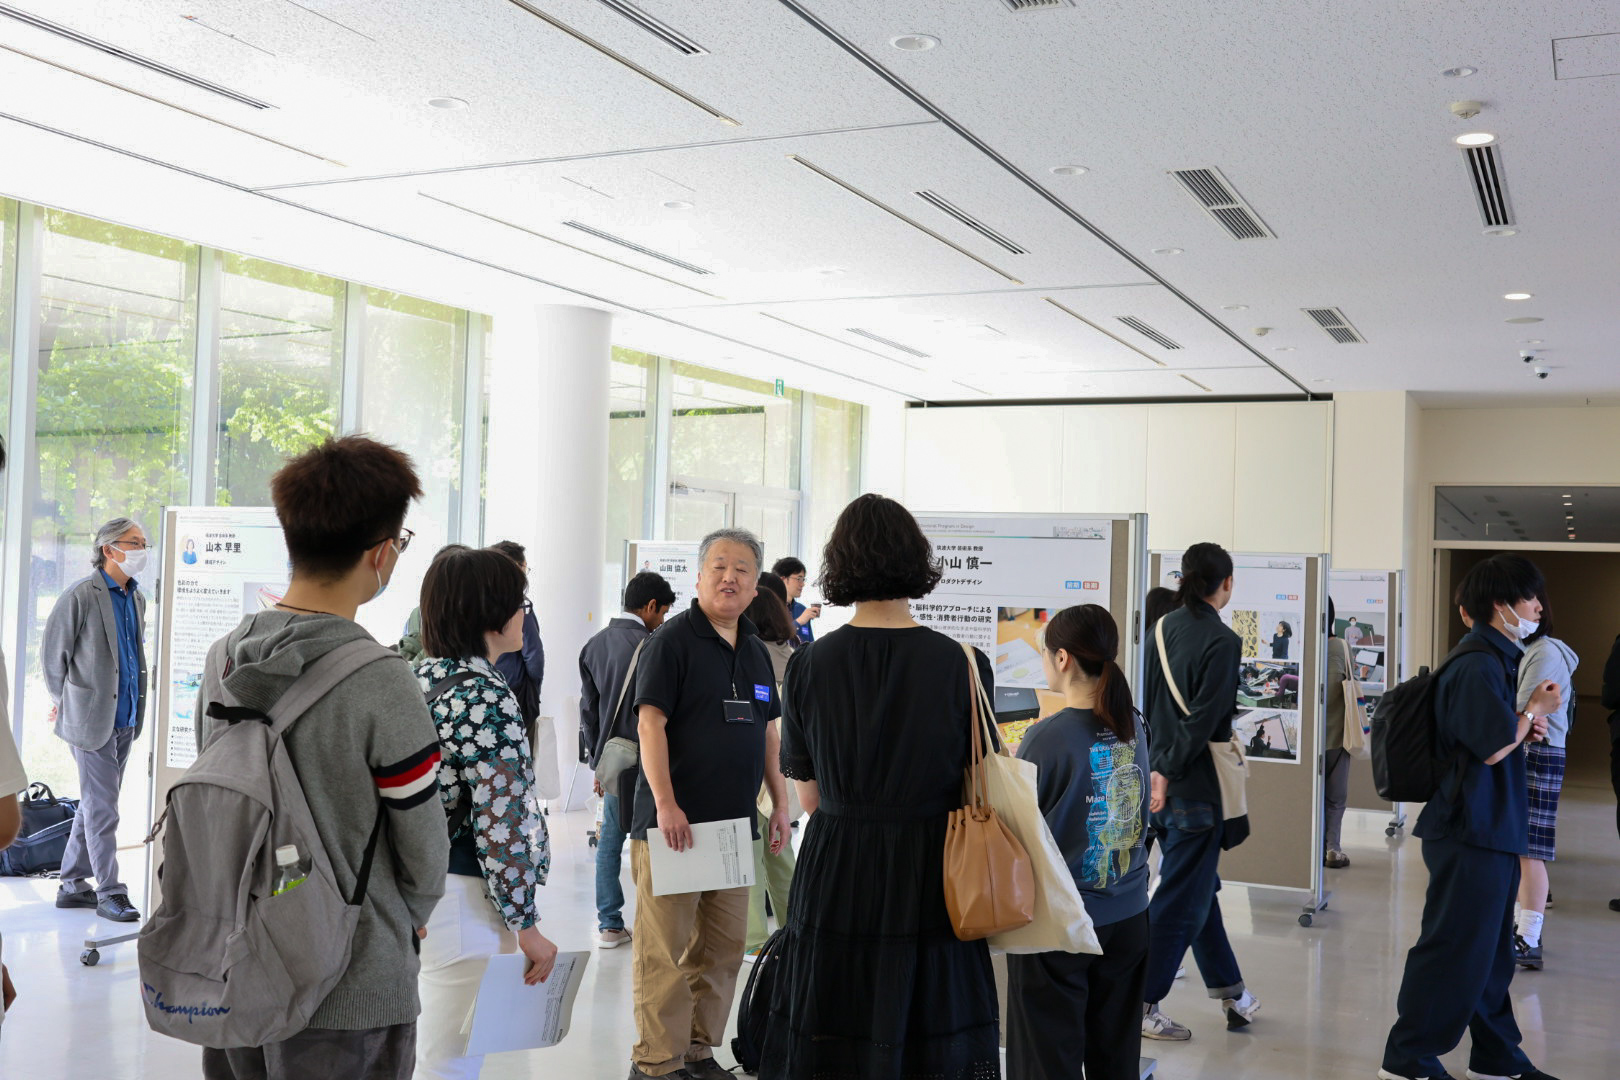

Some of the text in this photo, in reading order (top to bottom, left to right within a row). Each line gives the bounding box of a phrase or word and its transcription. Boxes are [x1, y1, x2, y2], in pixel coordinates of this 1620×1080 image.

[206, 542, 241, 553] 山本 早里
[936, 555, 992, 570] 小山 慎一
[938, 578, 983, 586] ロダクトデザイン
[142, 982, 231, 1024] Champion
